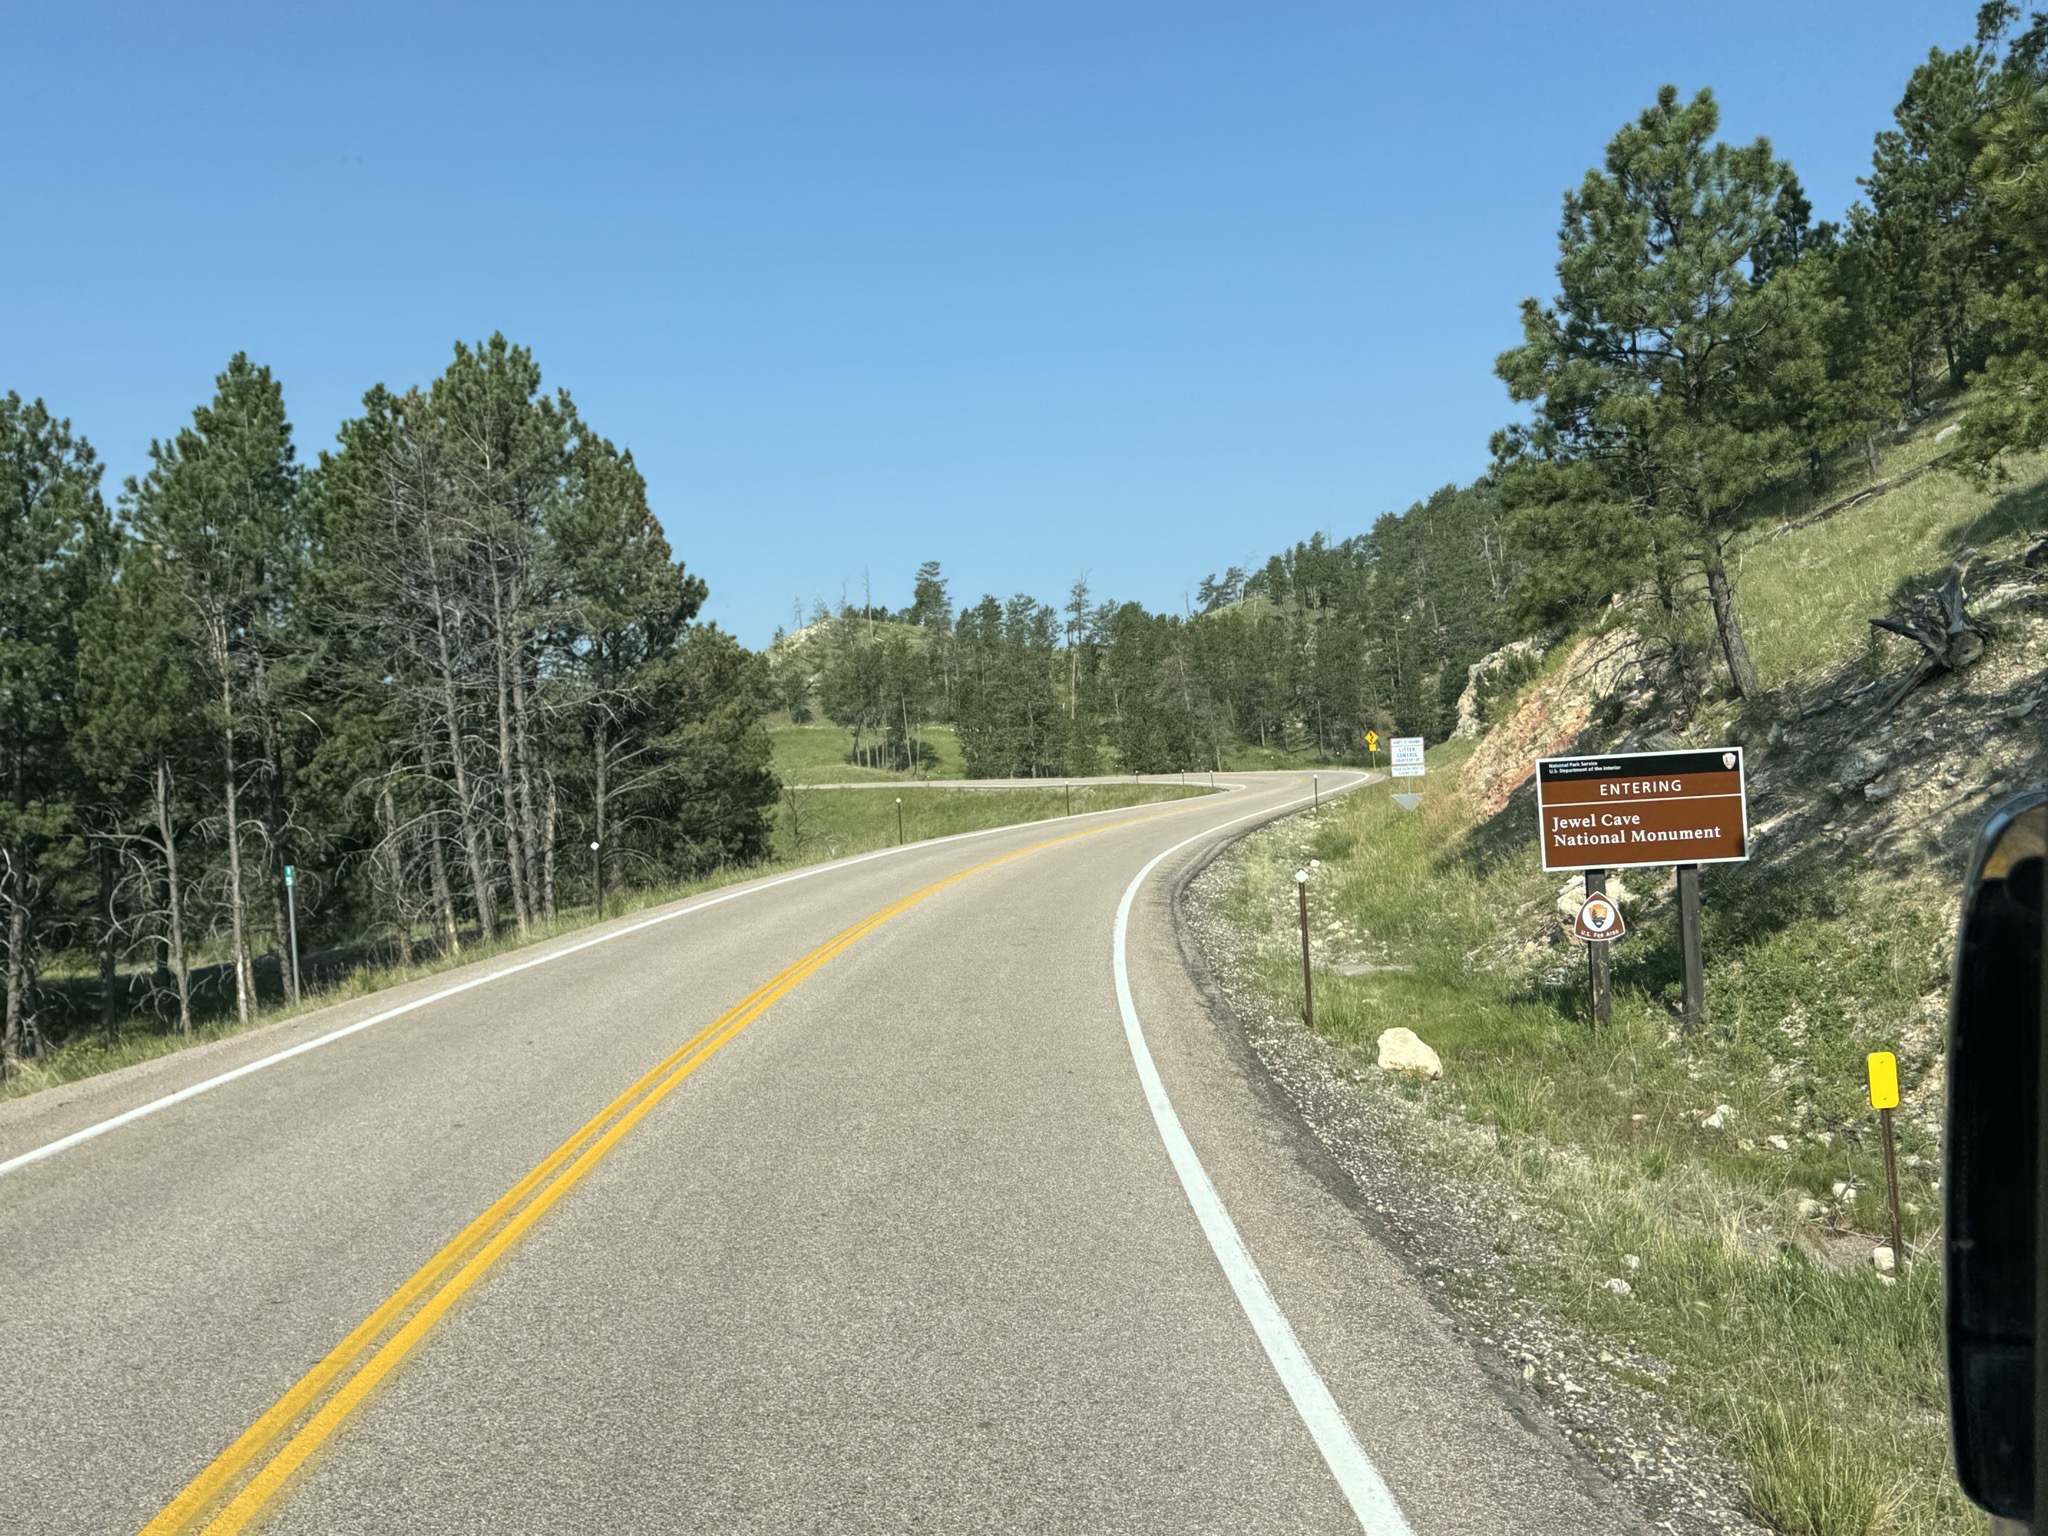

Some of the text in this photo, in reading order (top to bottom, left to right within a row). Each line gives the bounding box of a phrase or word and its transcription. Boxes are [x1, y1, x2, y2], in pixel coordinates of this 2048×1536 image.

[1559, 766, 1588, 774] Department
[1599, 779, 1682, 797] ENTERING
[1551, 813, 1641, 832] Jewel Cave
[1553, 826, 1722, 848] National Monument
[1580, 930, 1592, 938] U.S.
[1606, 929, 1620, 937] Area
